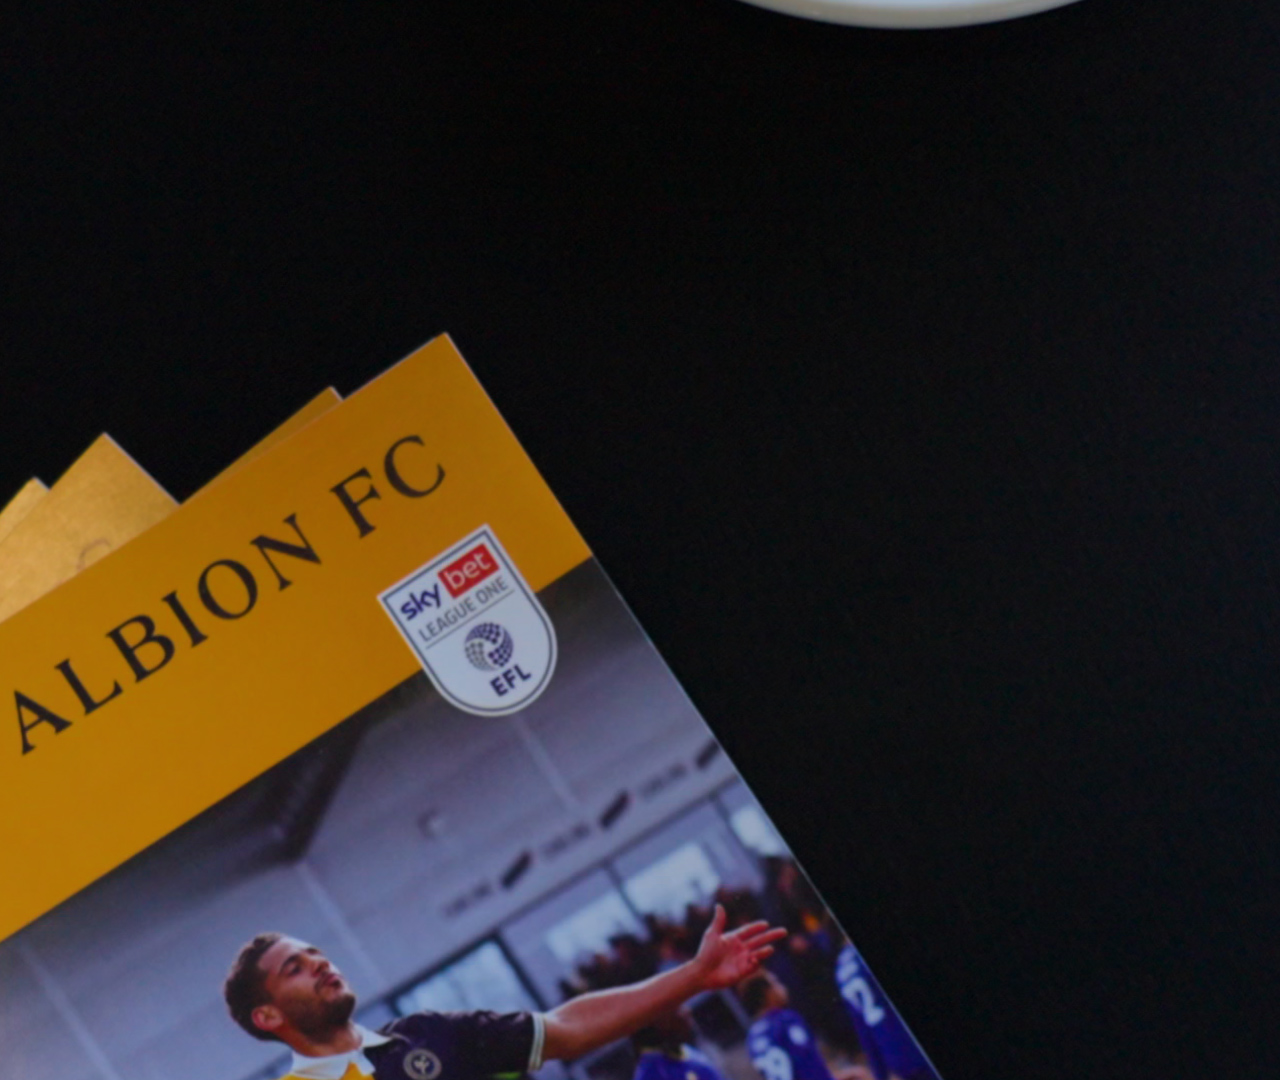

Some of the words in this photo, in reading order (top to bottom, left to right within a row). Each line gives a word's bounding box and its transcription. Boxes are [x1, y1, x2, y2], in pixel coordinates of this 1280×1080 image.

[13, 512, 322, 757] ALBION
[330, 434, 446, 539] FC
[400, 583, 442, 621] sky
[443, 552, 491, 589] bet
[418, 600, 475, 643] LEAGUE
[475, 576, 509, 605] ONE
[489, 664, 532, 697] EFL
